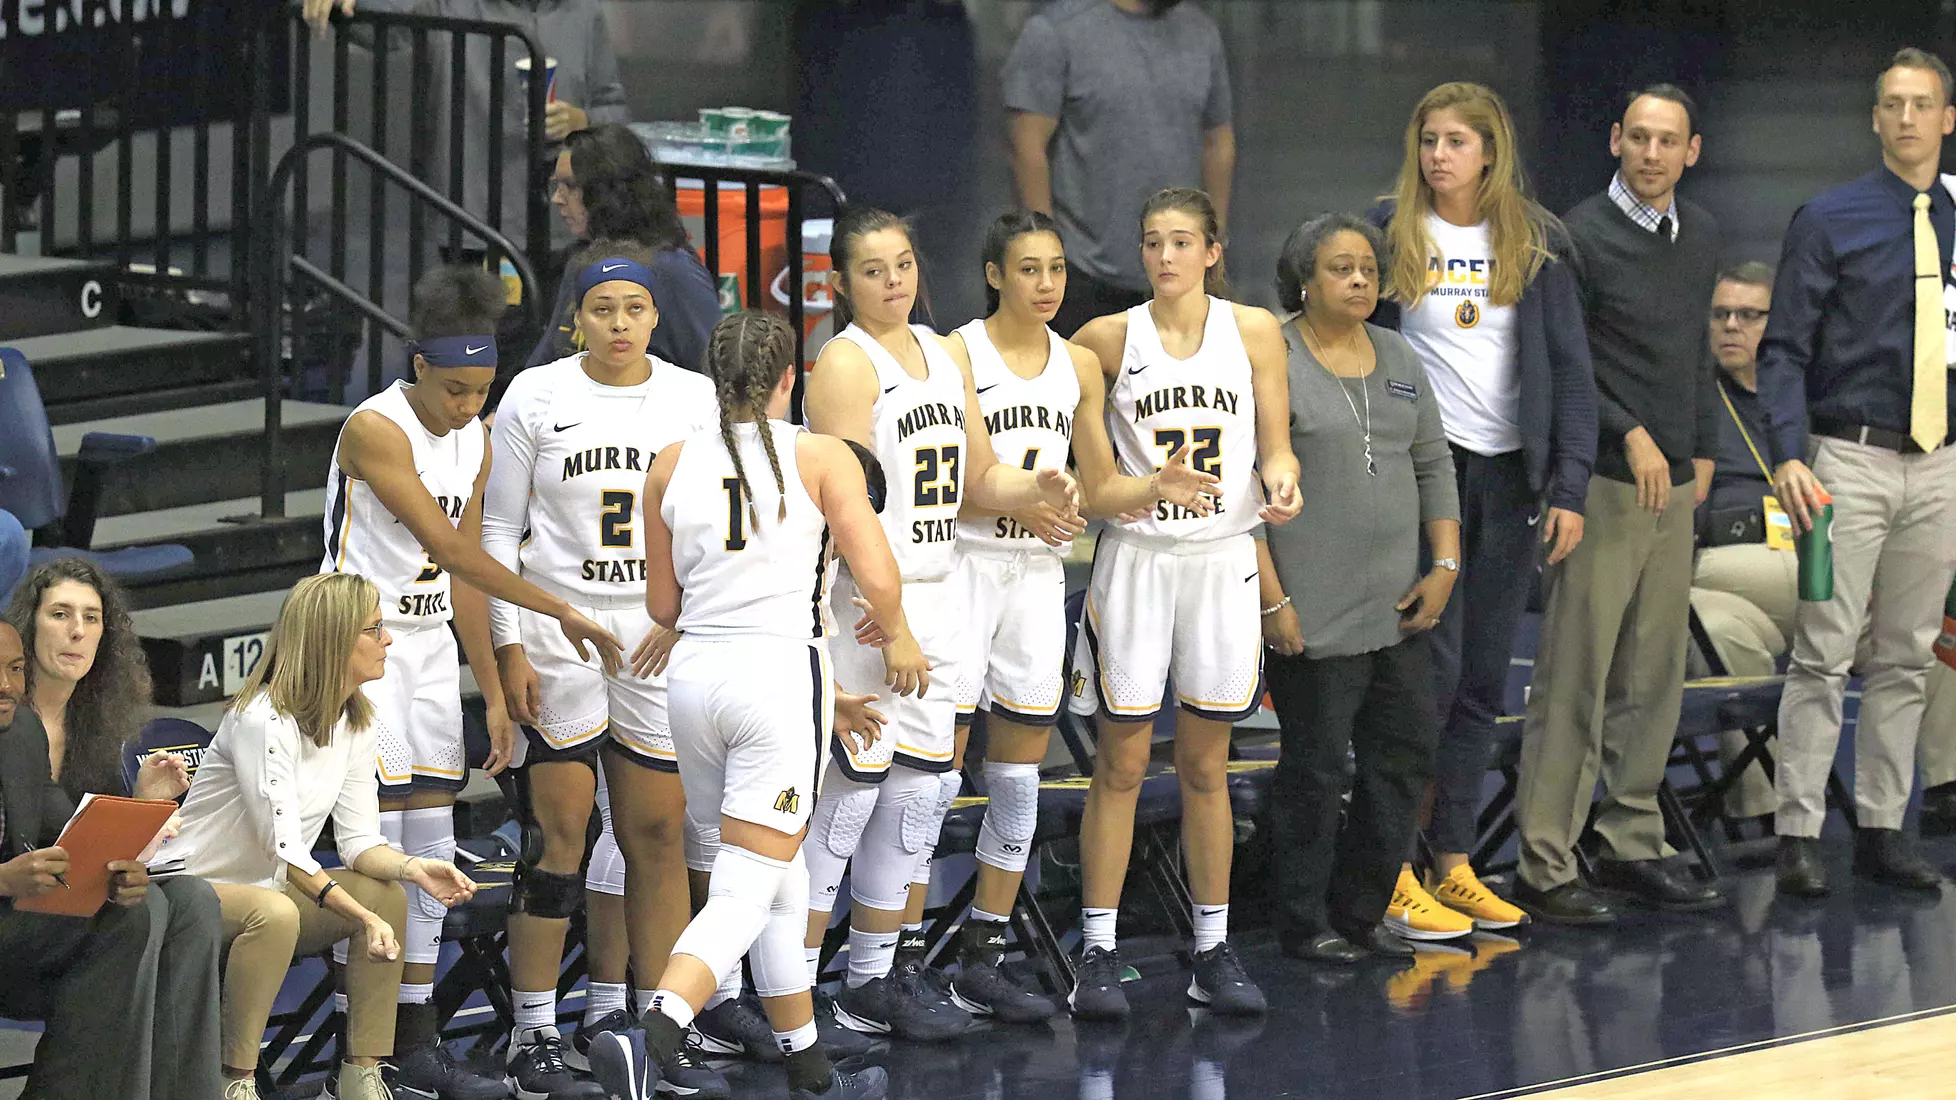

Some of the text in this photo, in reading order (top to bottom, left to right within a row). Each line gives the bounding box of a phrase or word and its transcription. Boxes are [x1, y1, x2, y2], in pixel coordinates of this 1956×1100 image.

[81, 280, 102, 318] C
[1134, 385, 1238, 424] MURRAY
[561, 446, 657, 482] MURR
[914, 444, 960, 509] 23
[600, 488, 636, 549] 2
[722, 475, 748, 553] 1
[912, 517, 957, 544] STAT
[198, 638, 263, 690] A 12
